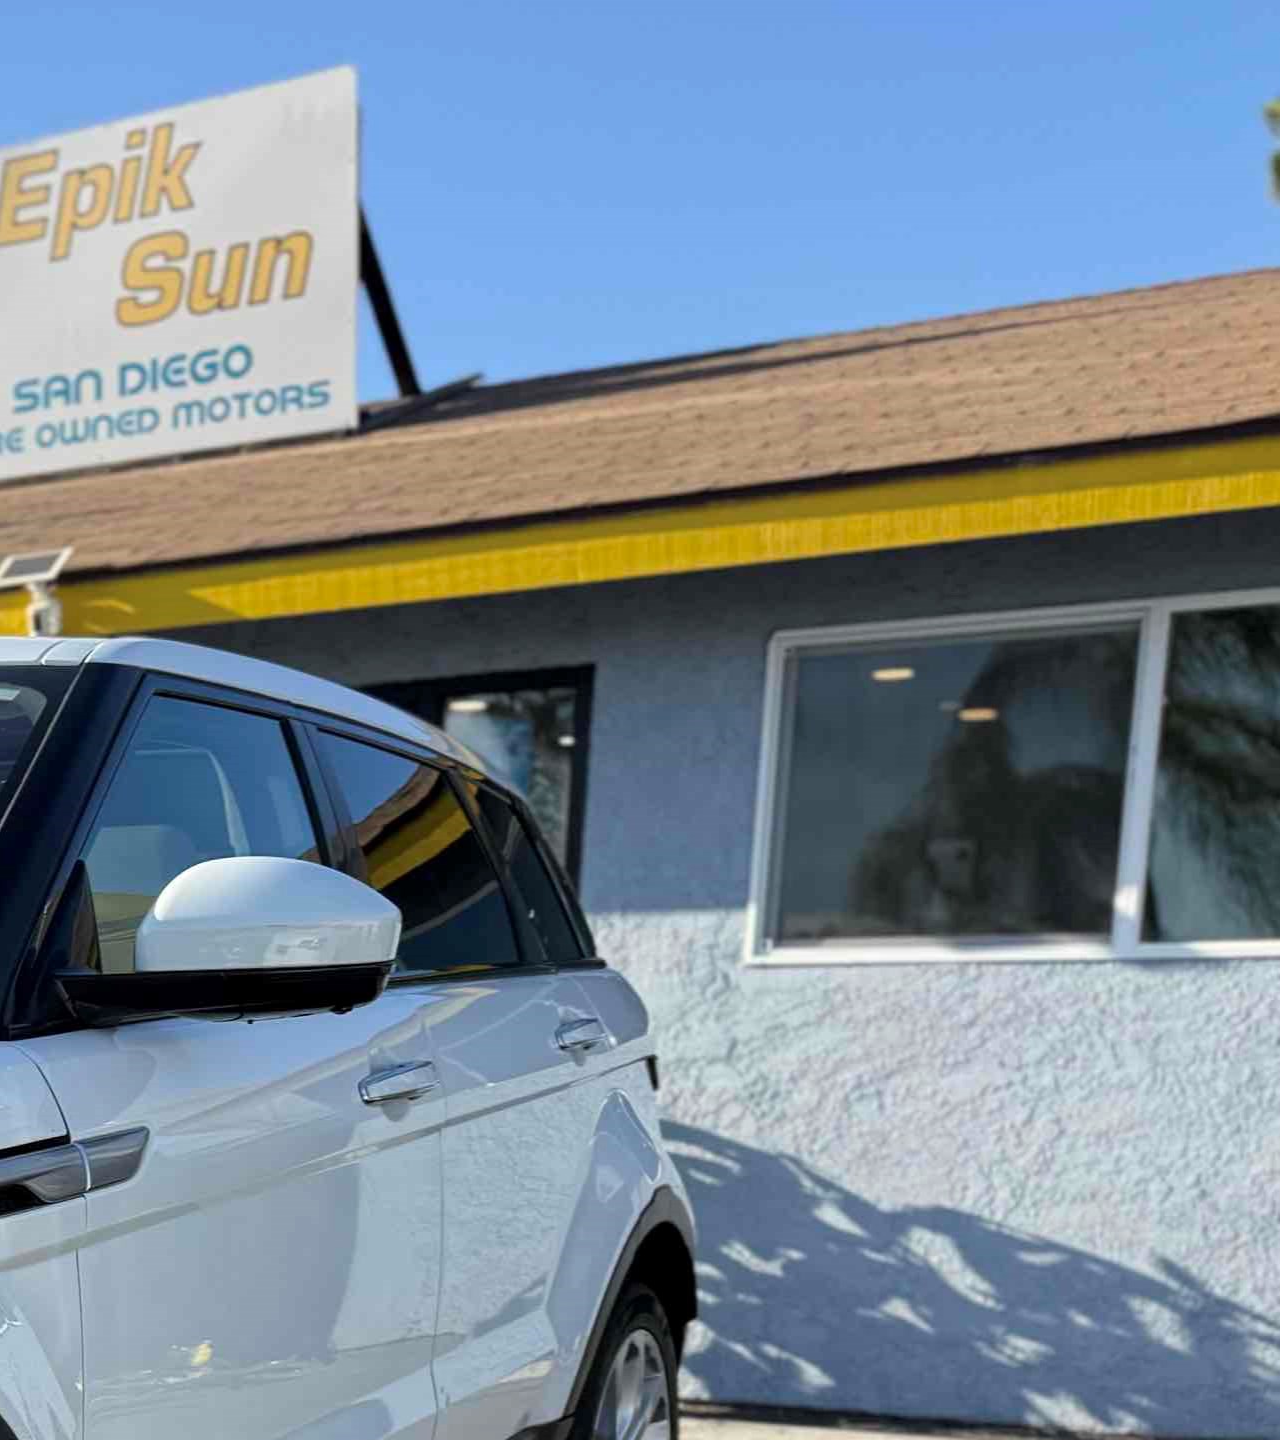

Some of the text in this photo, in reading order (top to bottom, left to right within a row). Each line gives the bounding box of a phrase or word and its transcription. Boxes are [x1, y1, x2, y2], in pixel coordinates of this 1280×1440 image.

[115, 230, 313, 327] Sun
[13, 344, 253, 414] SAN DIEGO
[36, 409, 159, 449] OWNED
[172, 380, 331, 429] MOTORS
